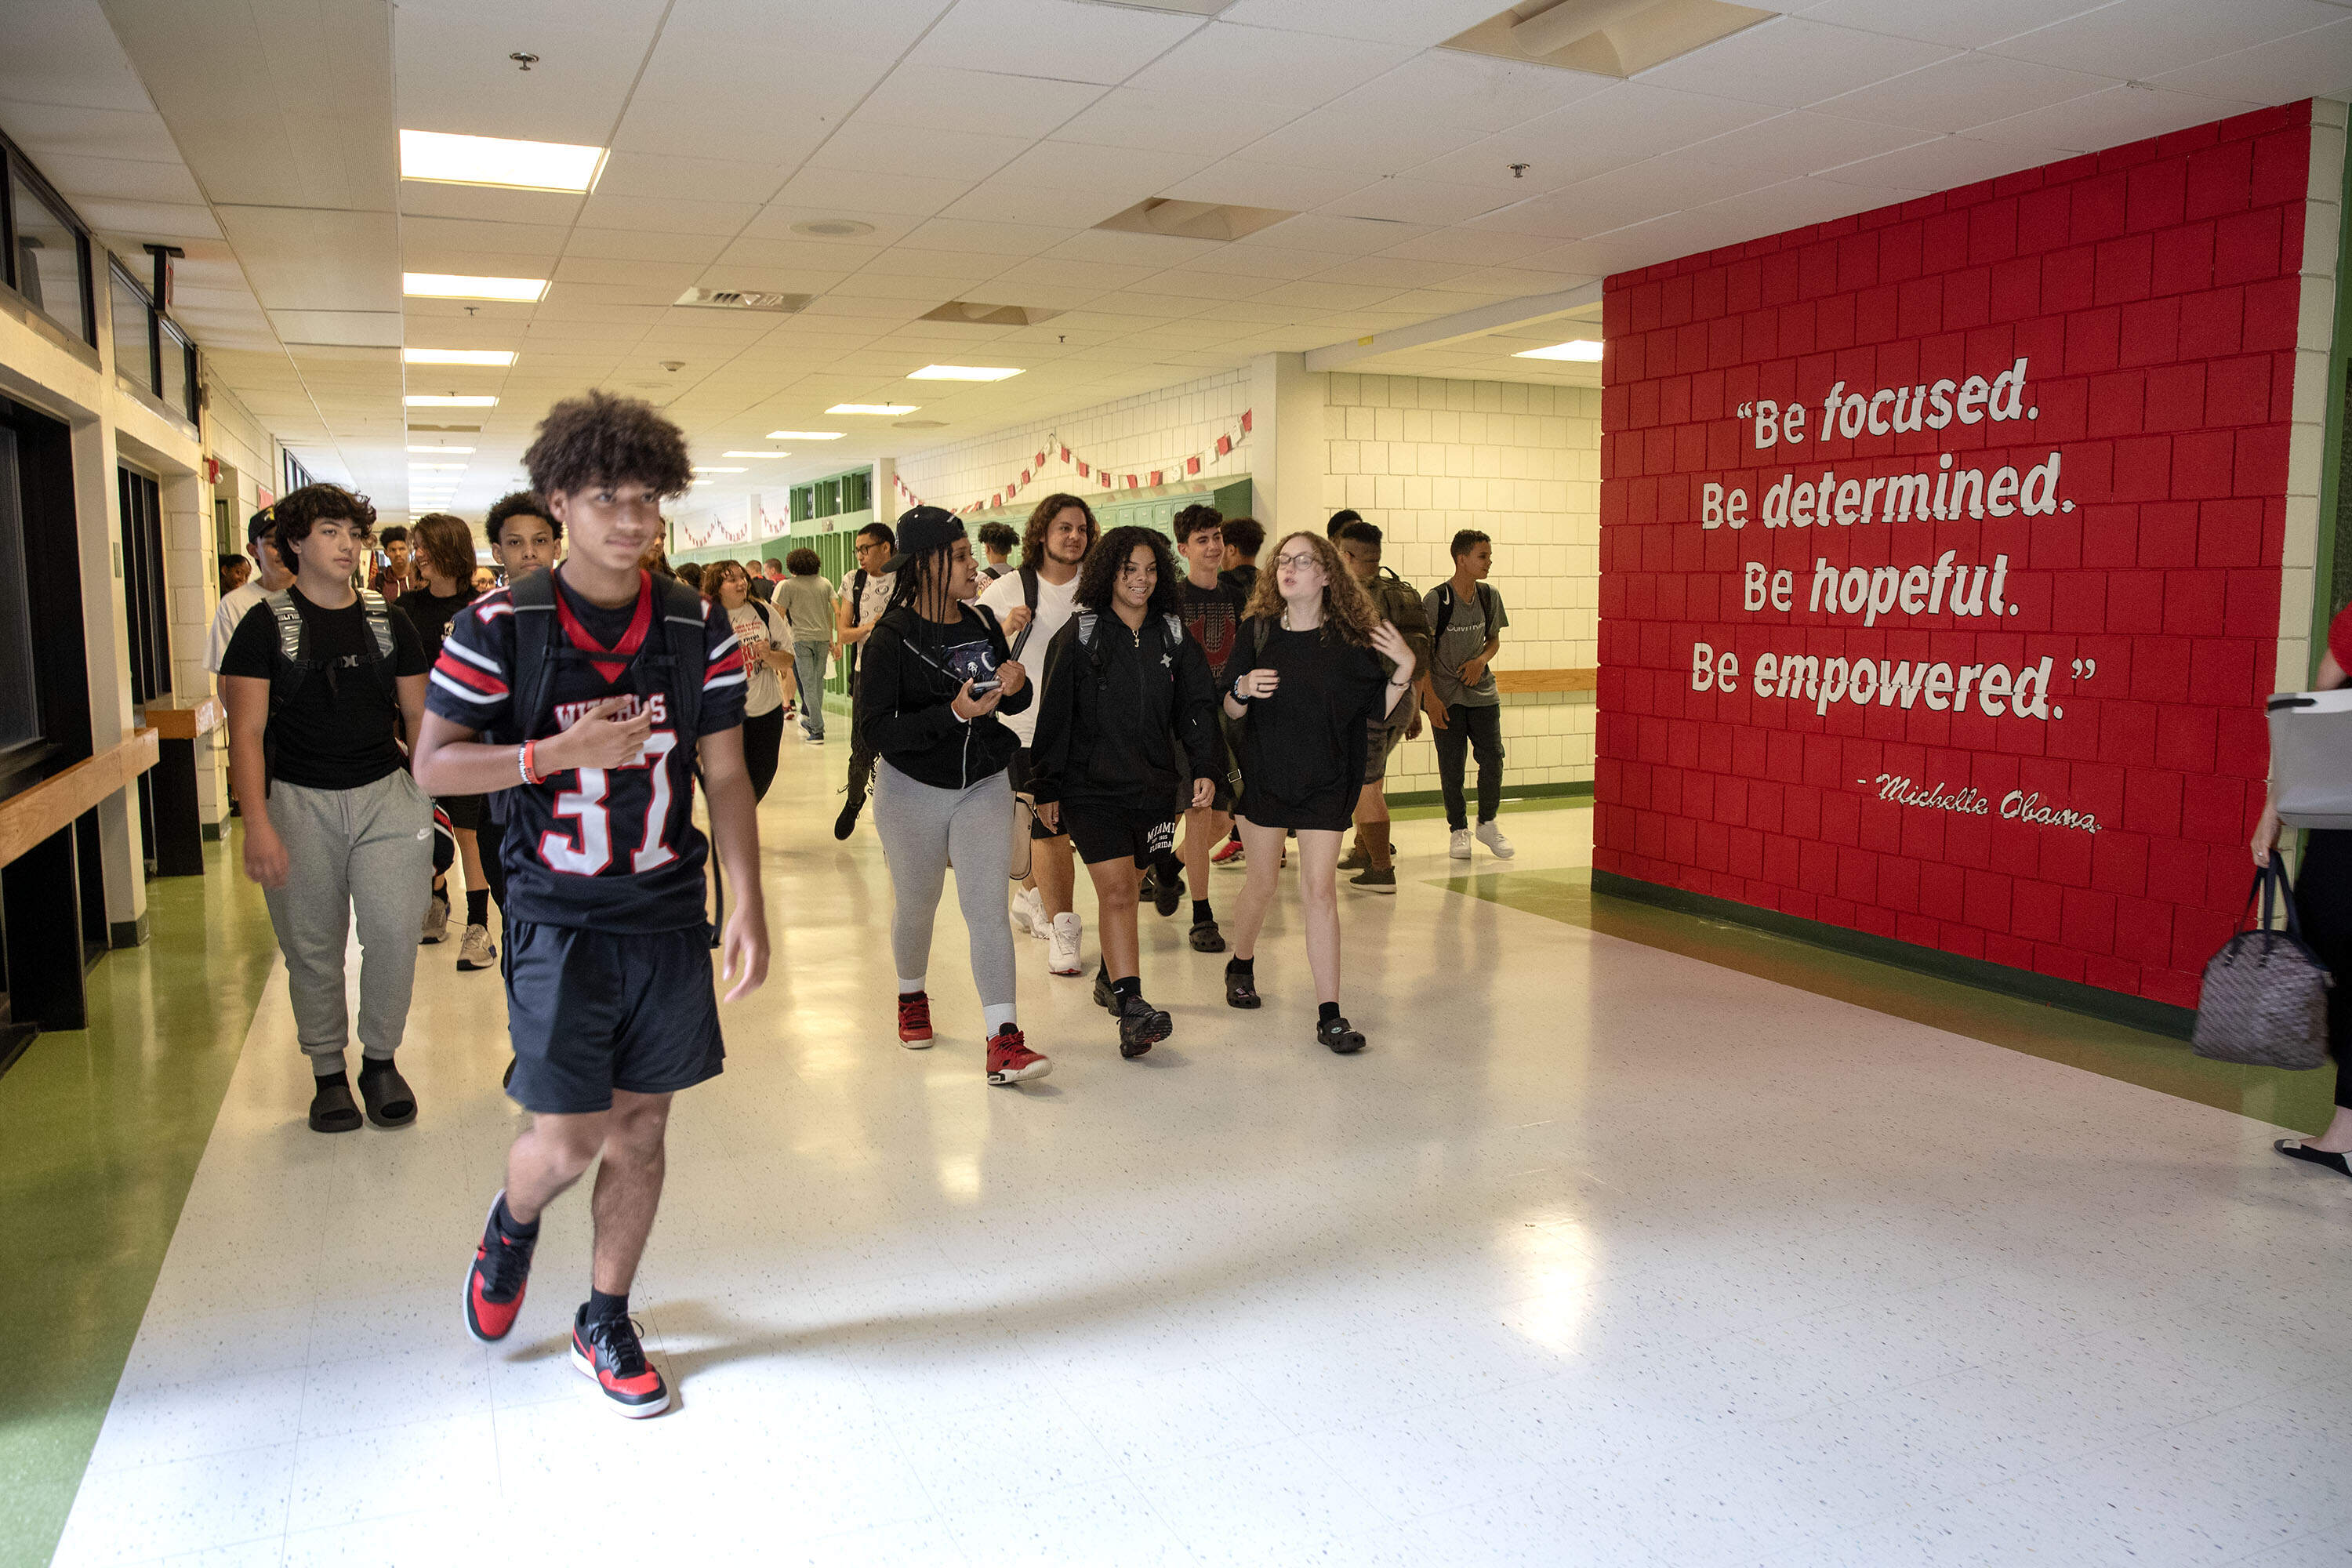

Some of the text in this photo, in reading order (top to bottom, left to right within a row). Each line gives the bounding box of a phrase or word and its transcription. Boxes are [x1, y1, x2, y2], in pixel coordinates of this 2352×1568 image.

[1820, 357, 2040, 442] focused.
[1701, 451, 2077, 530] Be determined.
[1744, 549, 2020, 628] Be hopeful.
[1691, 641, 1740, 694] Be
[538, 730, 680, 877] 37
[1875, 772, 1990, 815] Michelle
[1147, 822, 1175, 843] MIAMI
[1149, 840, 1172, 853] FLORIDA
